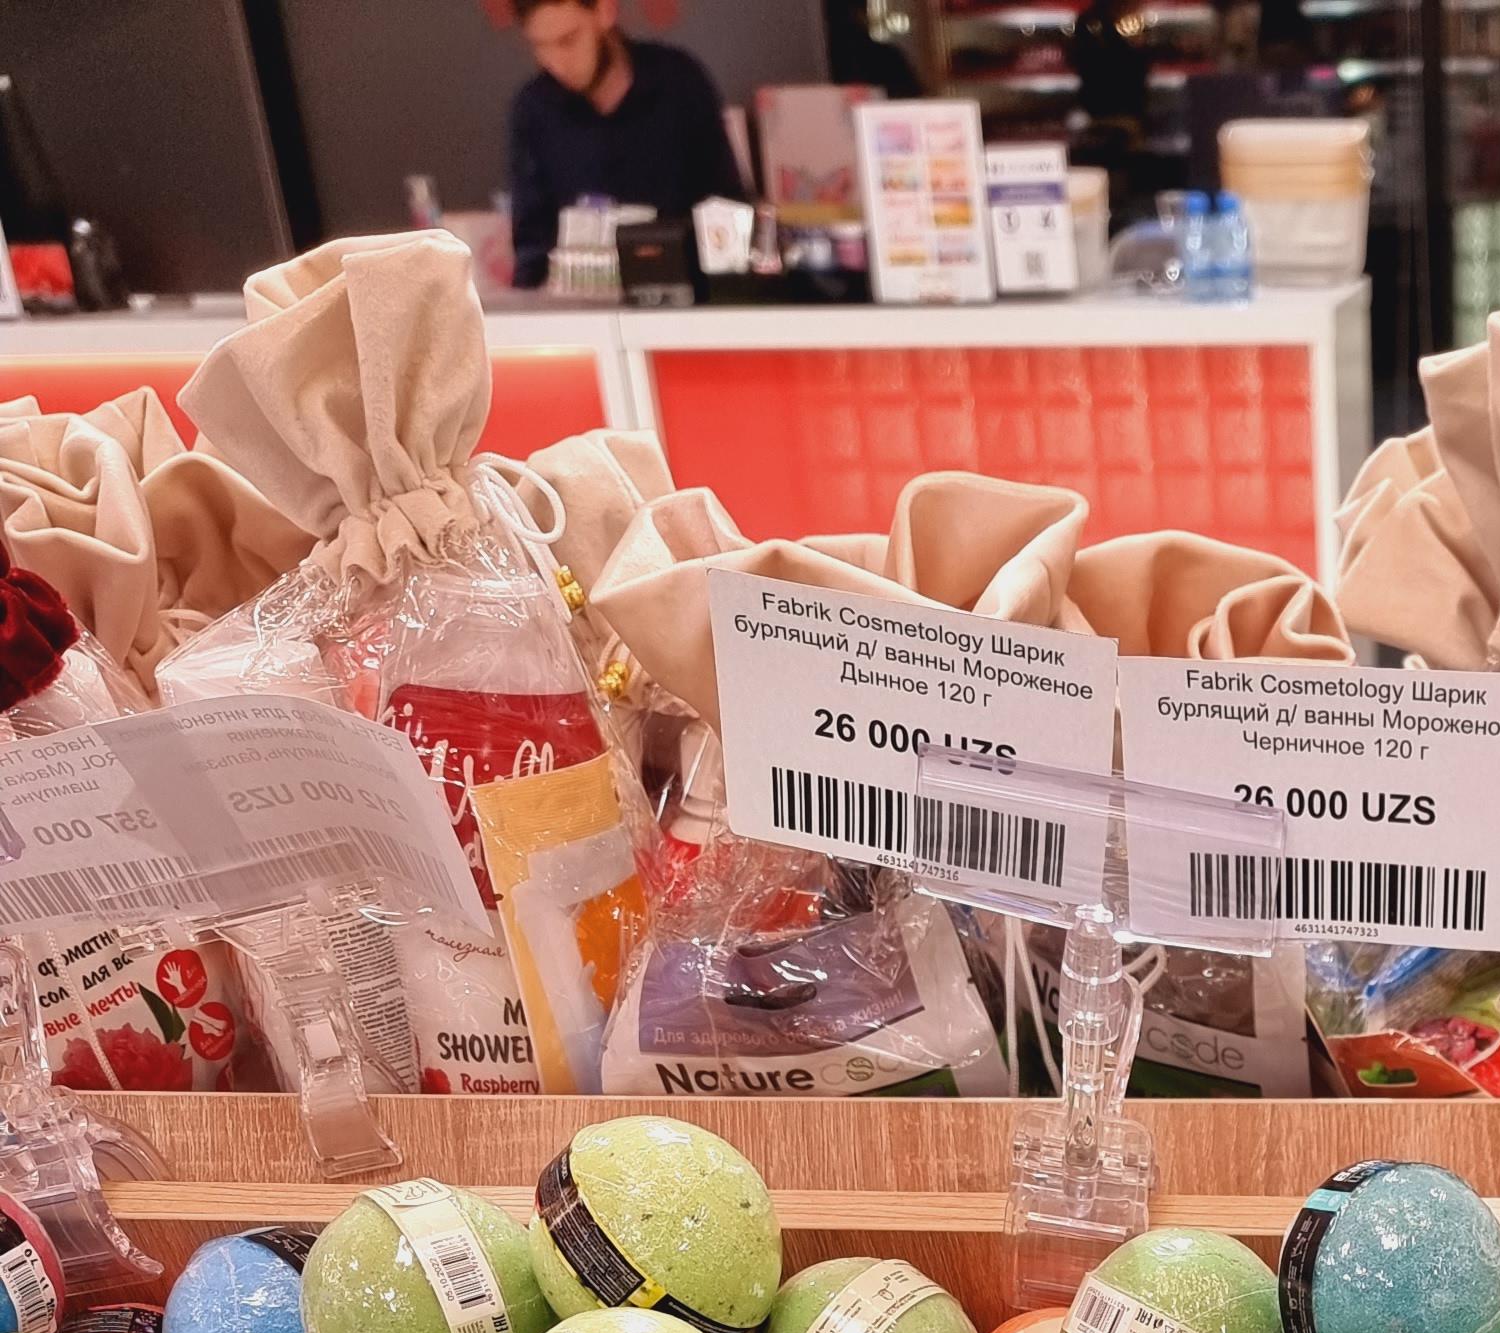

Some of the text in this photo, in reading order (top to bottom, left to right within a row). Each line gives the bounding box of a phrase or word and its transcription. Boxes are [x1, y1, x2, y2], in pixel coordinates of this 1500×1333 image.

[762, 592, 1065, 666] Fabrik Cosmetology Шарик
[734, 614, 1093, 699] бурлящий д/ ванны Мороженое
[841, 662, 992, 707] Дынное 120 г
[1186, 670, 1487, 708] Fabrik Cosmetology Шарик
[1158, 697, 1269, 725] бурлящий
[1276, 705, 1297, 726] д/
[1305, 711, 1374, 728] ванны
[814, 709, 855, 741] 26
[869, 720, 930, 757] 000
[1243, 731, 1429, 760] Черничное 120 г
[1287, 788, 1348, 820] 000
[1362, 793, 1436, 825] UZS
[1295, 924, 1379, 937] 4631141747323
[82, 964, 111, 990] для
[653, 1027, 687, 1046] Для
[656, 1062, 814, 1096] Nature
